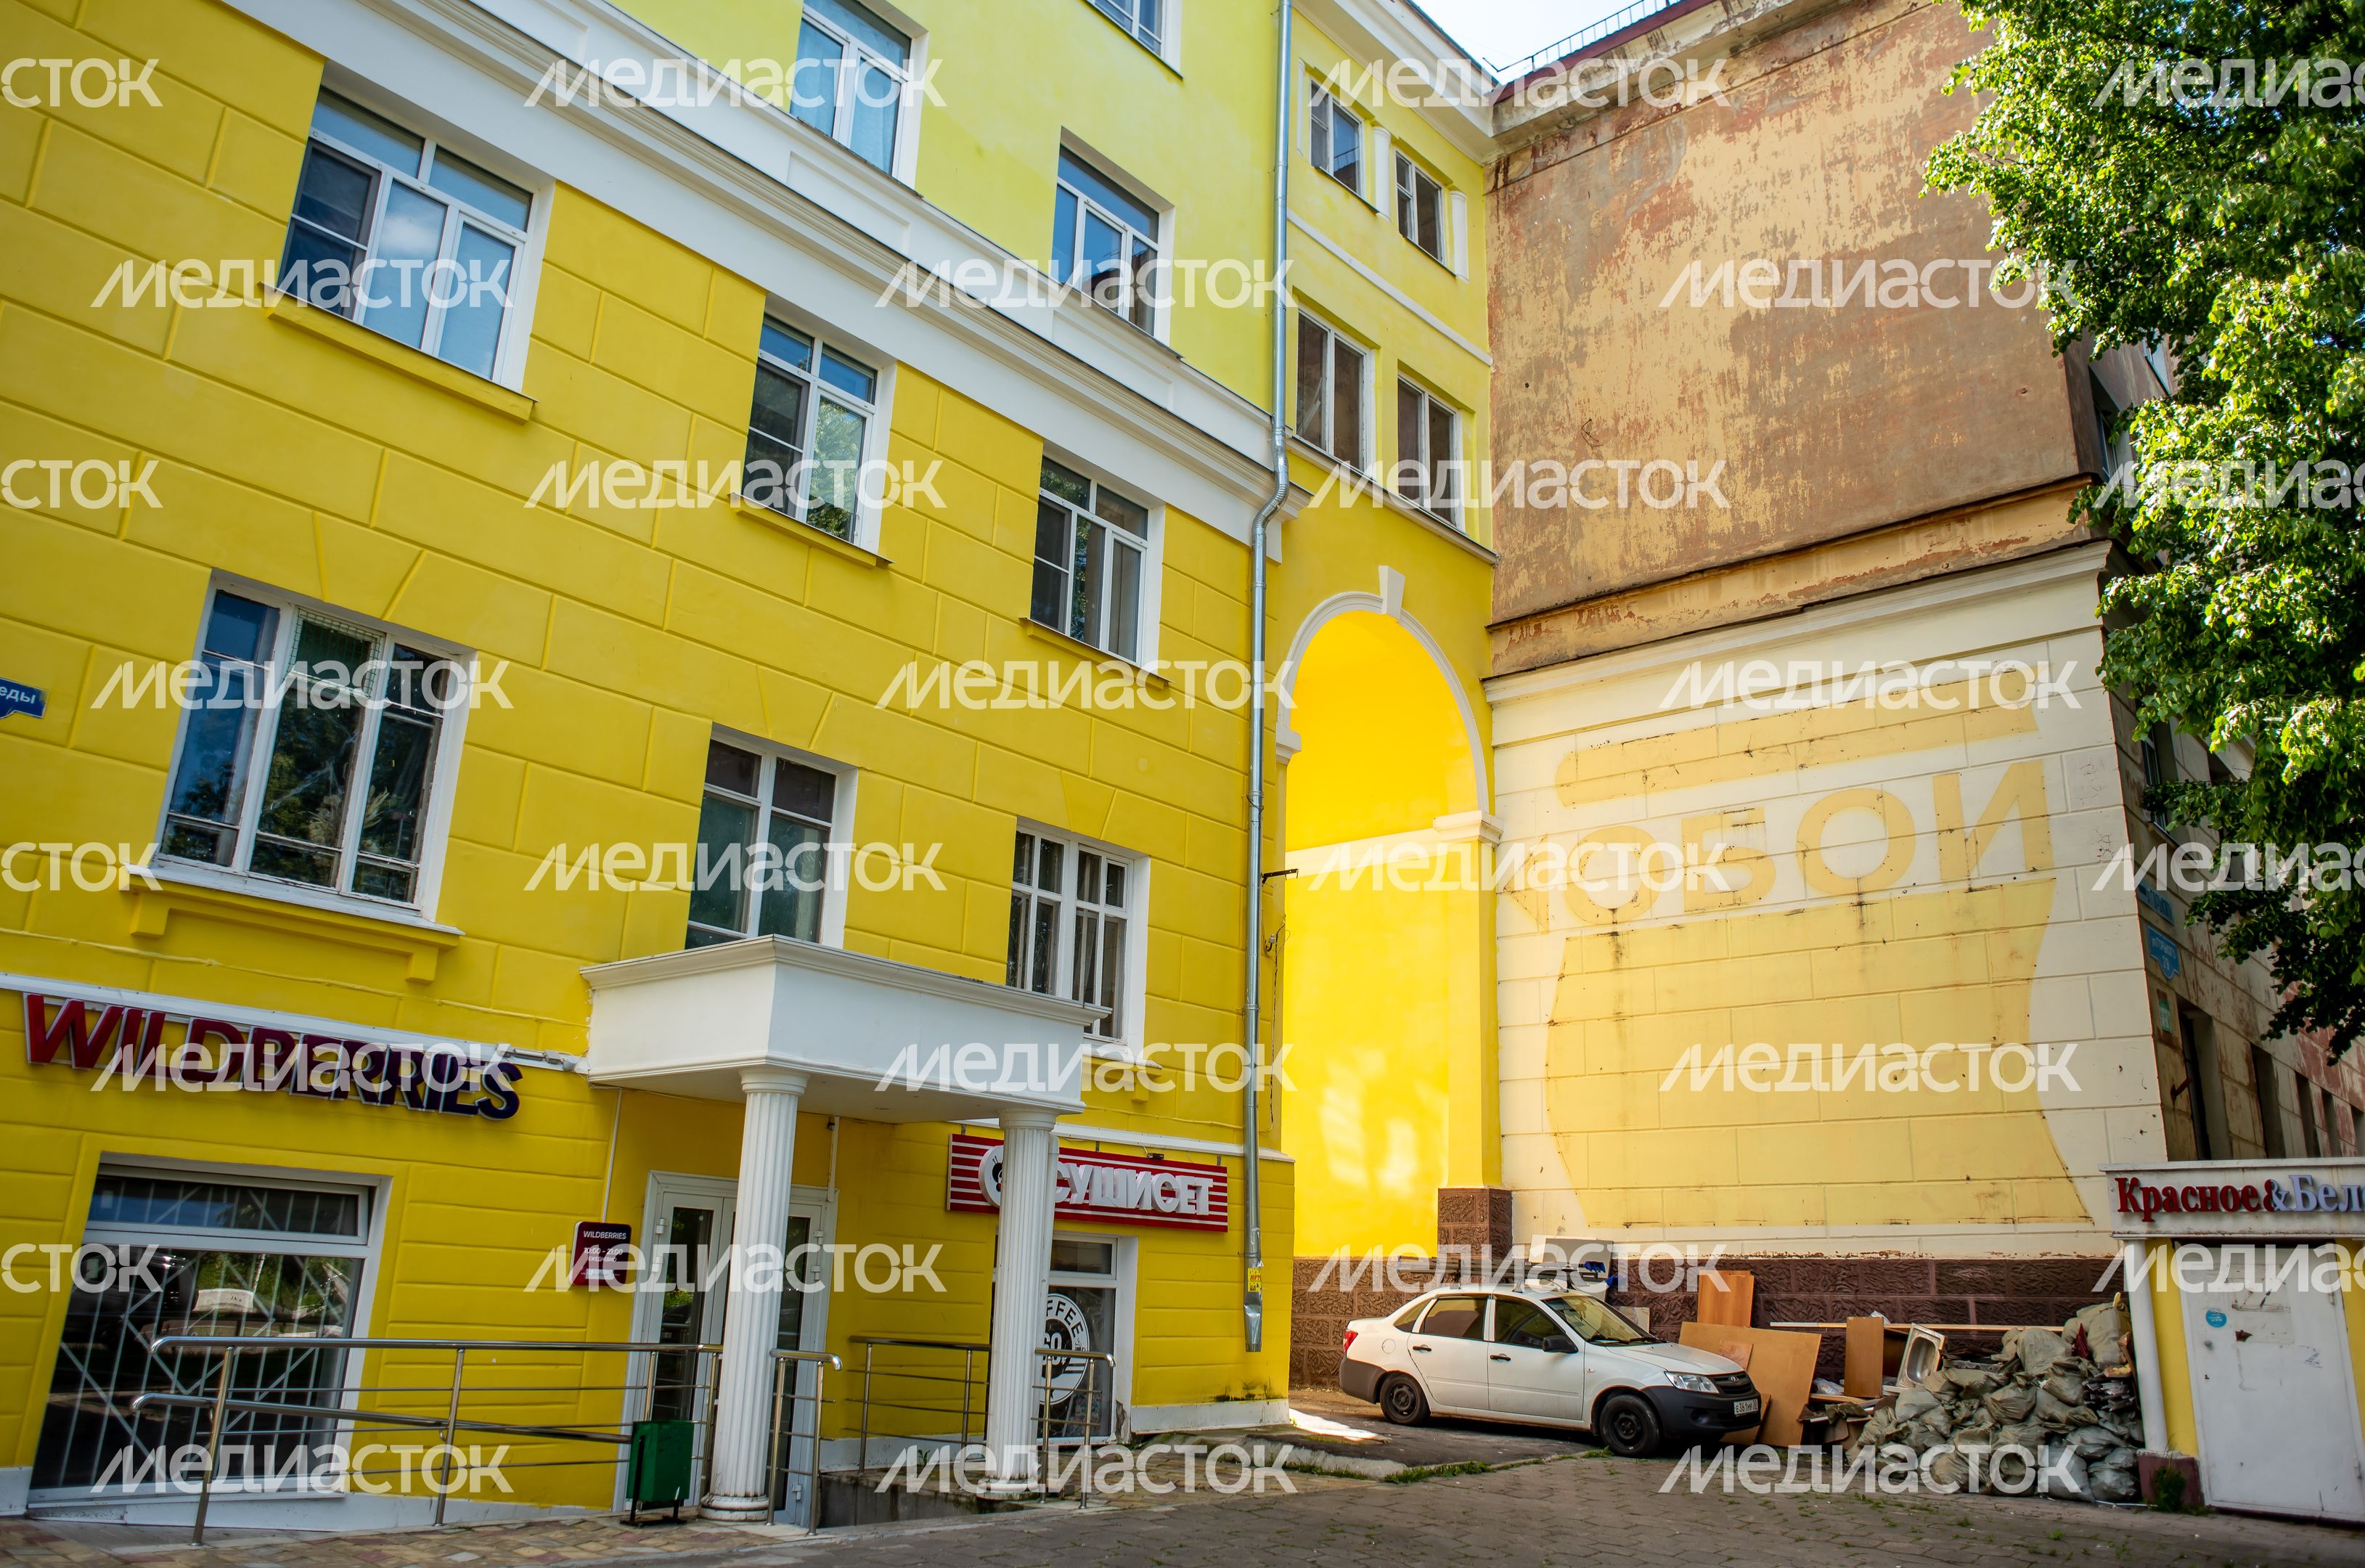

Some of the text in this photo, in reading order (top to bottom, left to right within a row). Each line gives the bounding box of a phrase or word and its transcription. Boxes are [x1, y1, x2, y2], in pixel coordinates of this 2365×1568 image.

[23, 992, 524, 1121] WILDBERRIES
[1055, 1161, 1214, 1216] СУШИСЕТ
[2115, 1174, 2365, 1222] Красное&Бел
[583, 1230, 626, 1239] WILDBERRIES
[1046, 1299, 1084, 1338] FFEE
